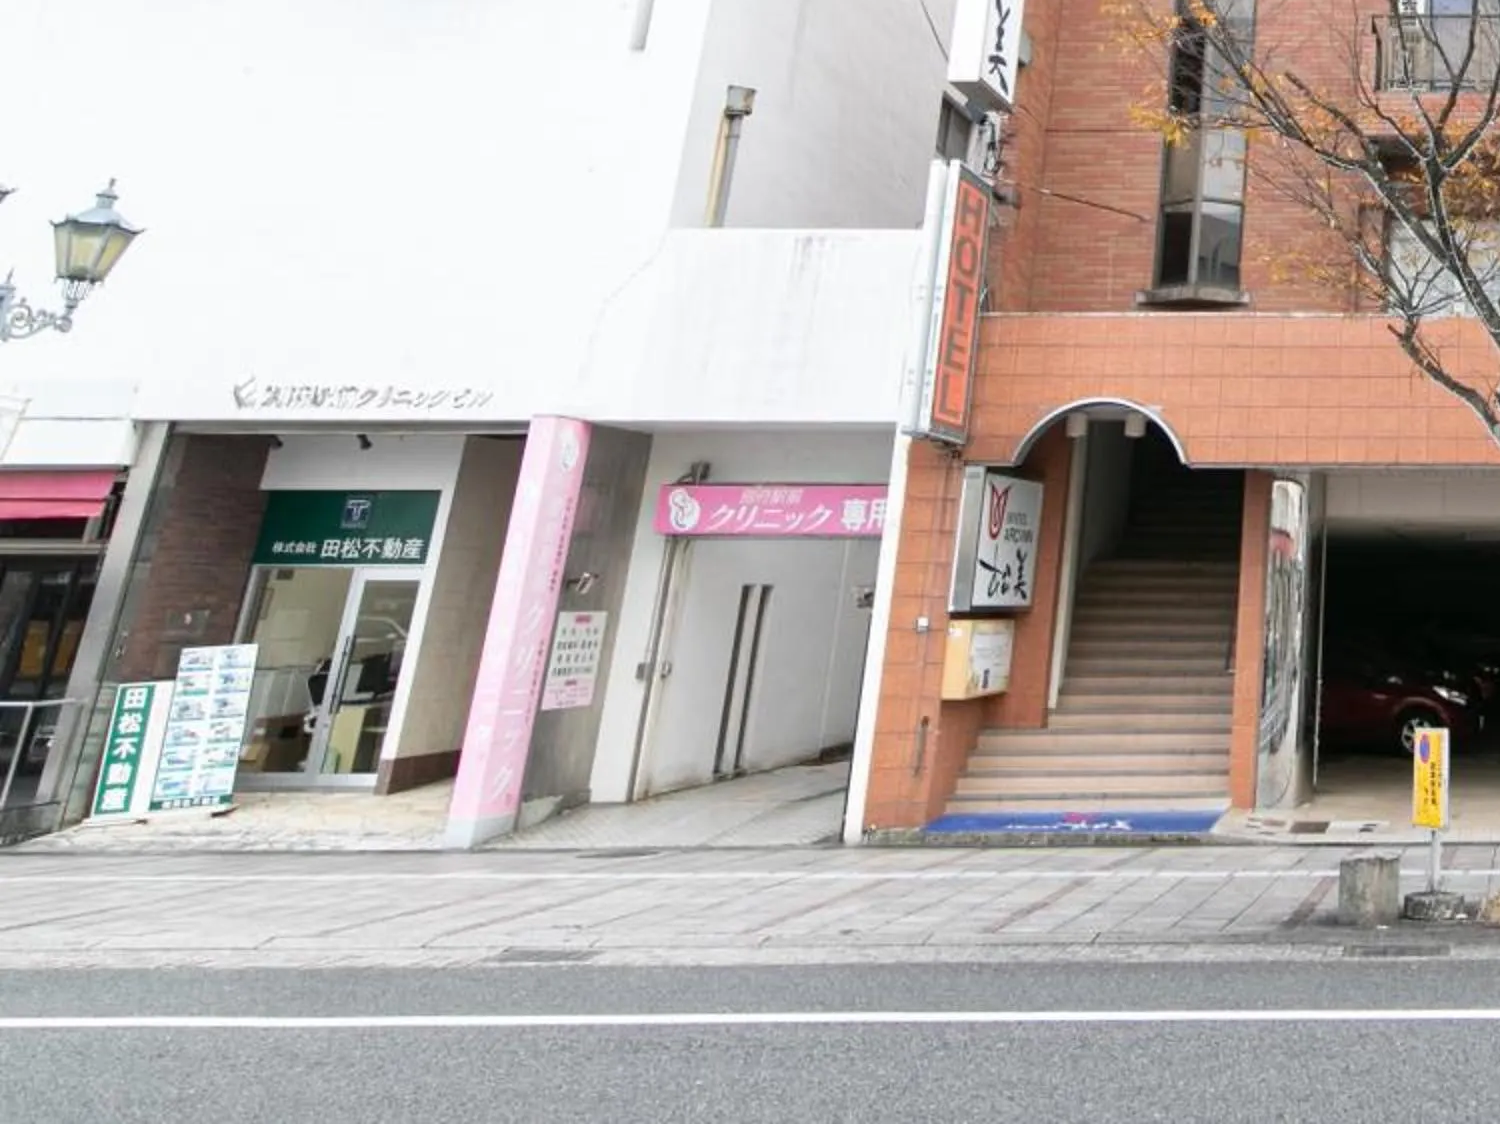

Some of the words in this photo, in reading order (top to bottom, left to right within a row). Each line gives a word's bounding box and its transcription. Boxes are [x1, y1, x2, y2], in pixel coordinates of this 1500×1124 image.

[939, 187, 982, 420] HOTEL
[705, 503, 833, 532] クリニック
[320, 537, 426, 559] 田松不動産
